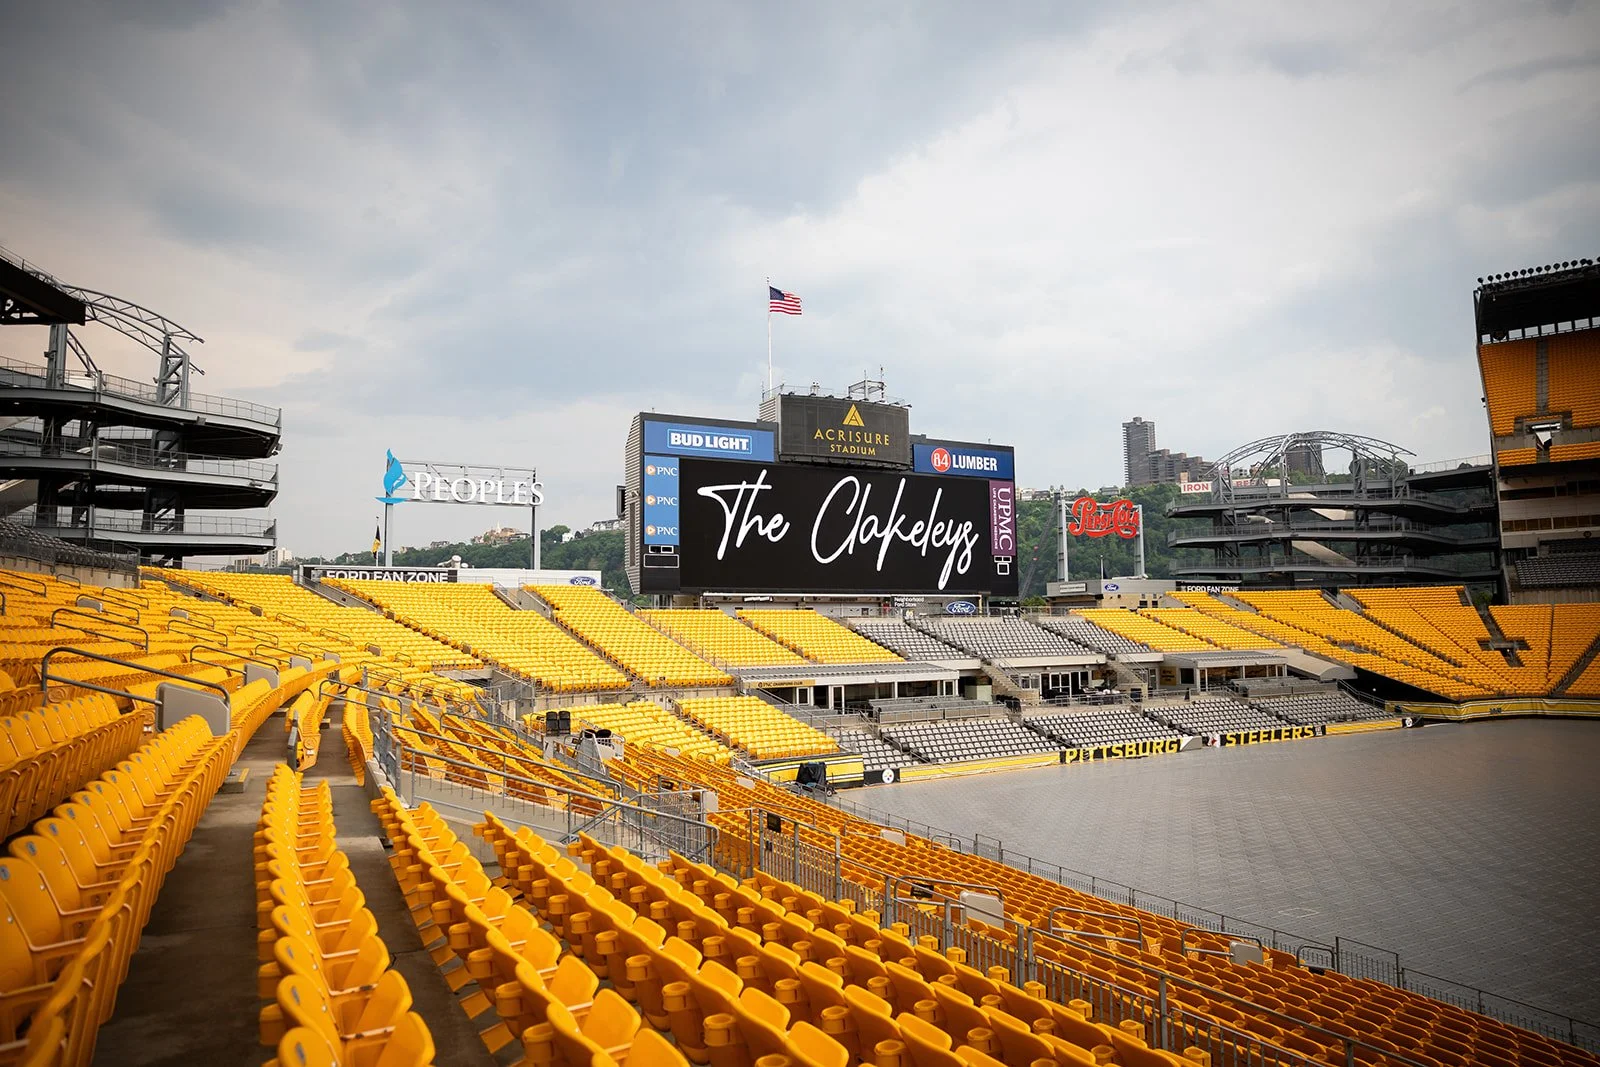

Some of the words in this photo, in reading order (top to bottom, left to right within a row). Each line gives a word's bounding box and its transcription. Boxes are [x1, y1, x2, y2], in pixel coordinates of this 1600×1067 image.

[670, 432, 704, 447] BUD
[705, 435, 750, 451] LIGHT
[813, 428, 890, 446] ACRISURE
[830, 443, 876, 456] STADIUM
[933, 452, 949, 468] 84
[952, 454, 998, 472] LUMBER
[657, 466, 678, 476] PNC
[413, 471, 545, 506] PEOPLES
[1183, 483, 1209, 492] IRON
[656, 496, 678, 506] PNC
[997, 487, 1013, 550] UPMC
[657, 526, 678, 536] PNC
[697, 468, 790, 561] The
[811, 475, 980, 590] Clakeleys
[326, 570, 370, 581] FORD
[373, 571, 404, 582] FAN
[406, 572, 449, 583] ZONE
[951, 603, 971, 613] Ford
[1065, 738, 1184, 764] PITTSBURG
[1225, 725, 1314, 747] STEELERS
